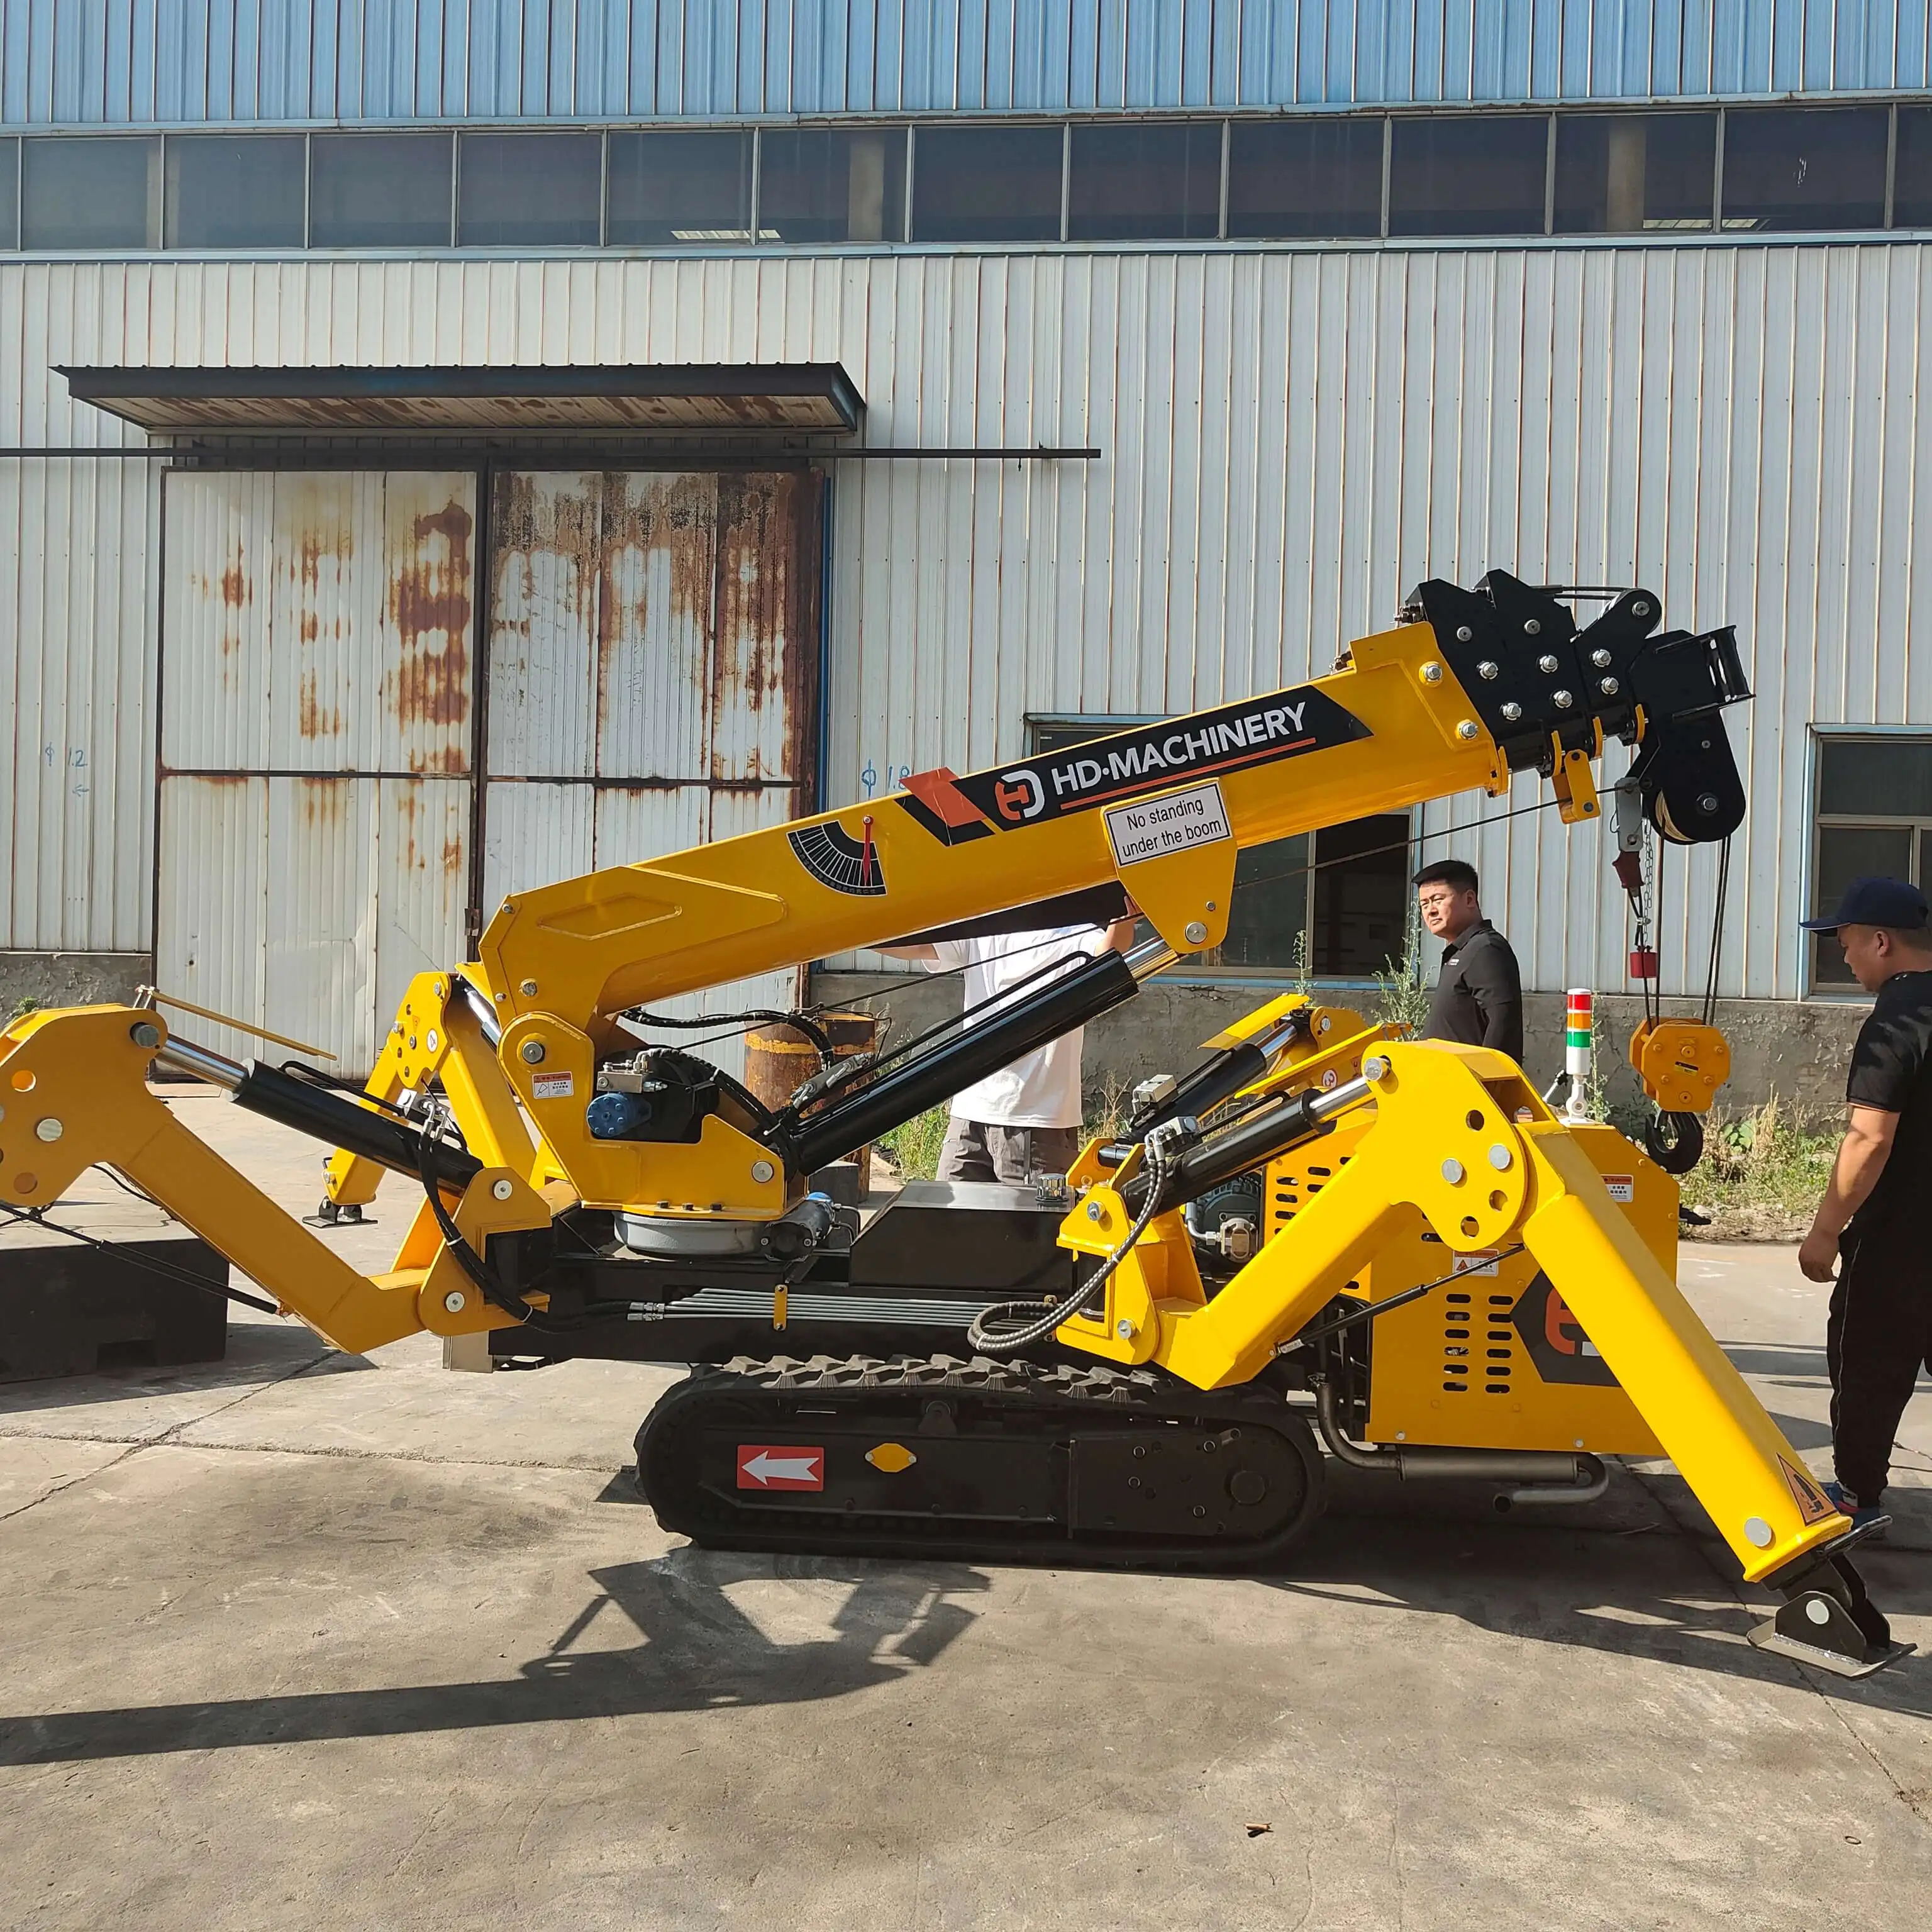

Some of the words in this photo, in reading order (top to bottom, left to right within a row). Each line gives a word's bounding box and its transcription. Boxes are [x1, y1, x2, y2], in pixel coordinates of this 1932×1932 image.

[1126, 814, 1146, 831] No
[1149, 798, 1204, 824] standing
[1122, 836, 1158, 857] under
[1161, 830, 1182, 847] the
[1185, 819, 1222, 840] boom
